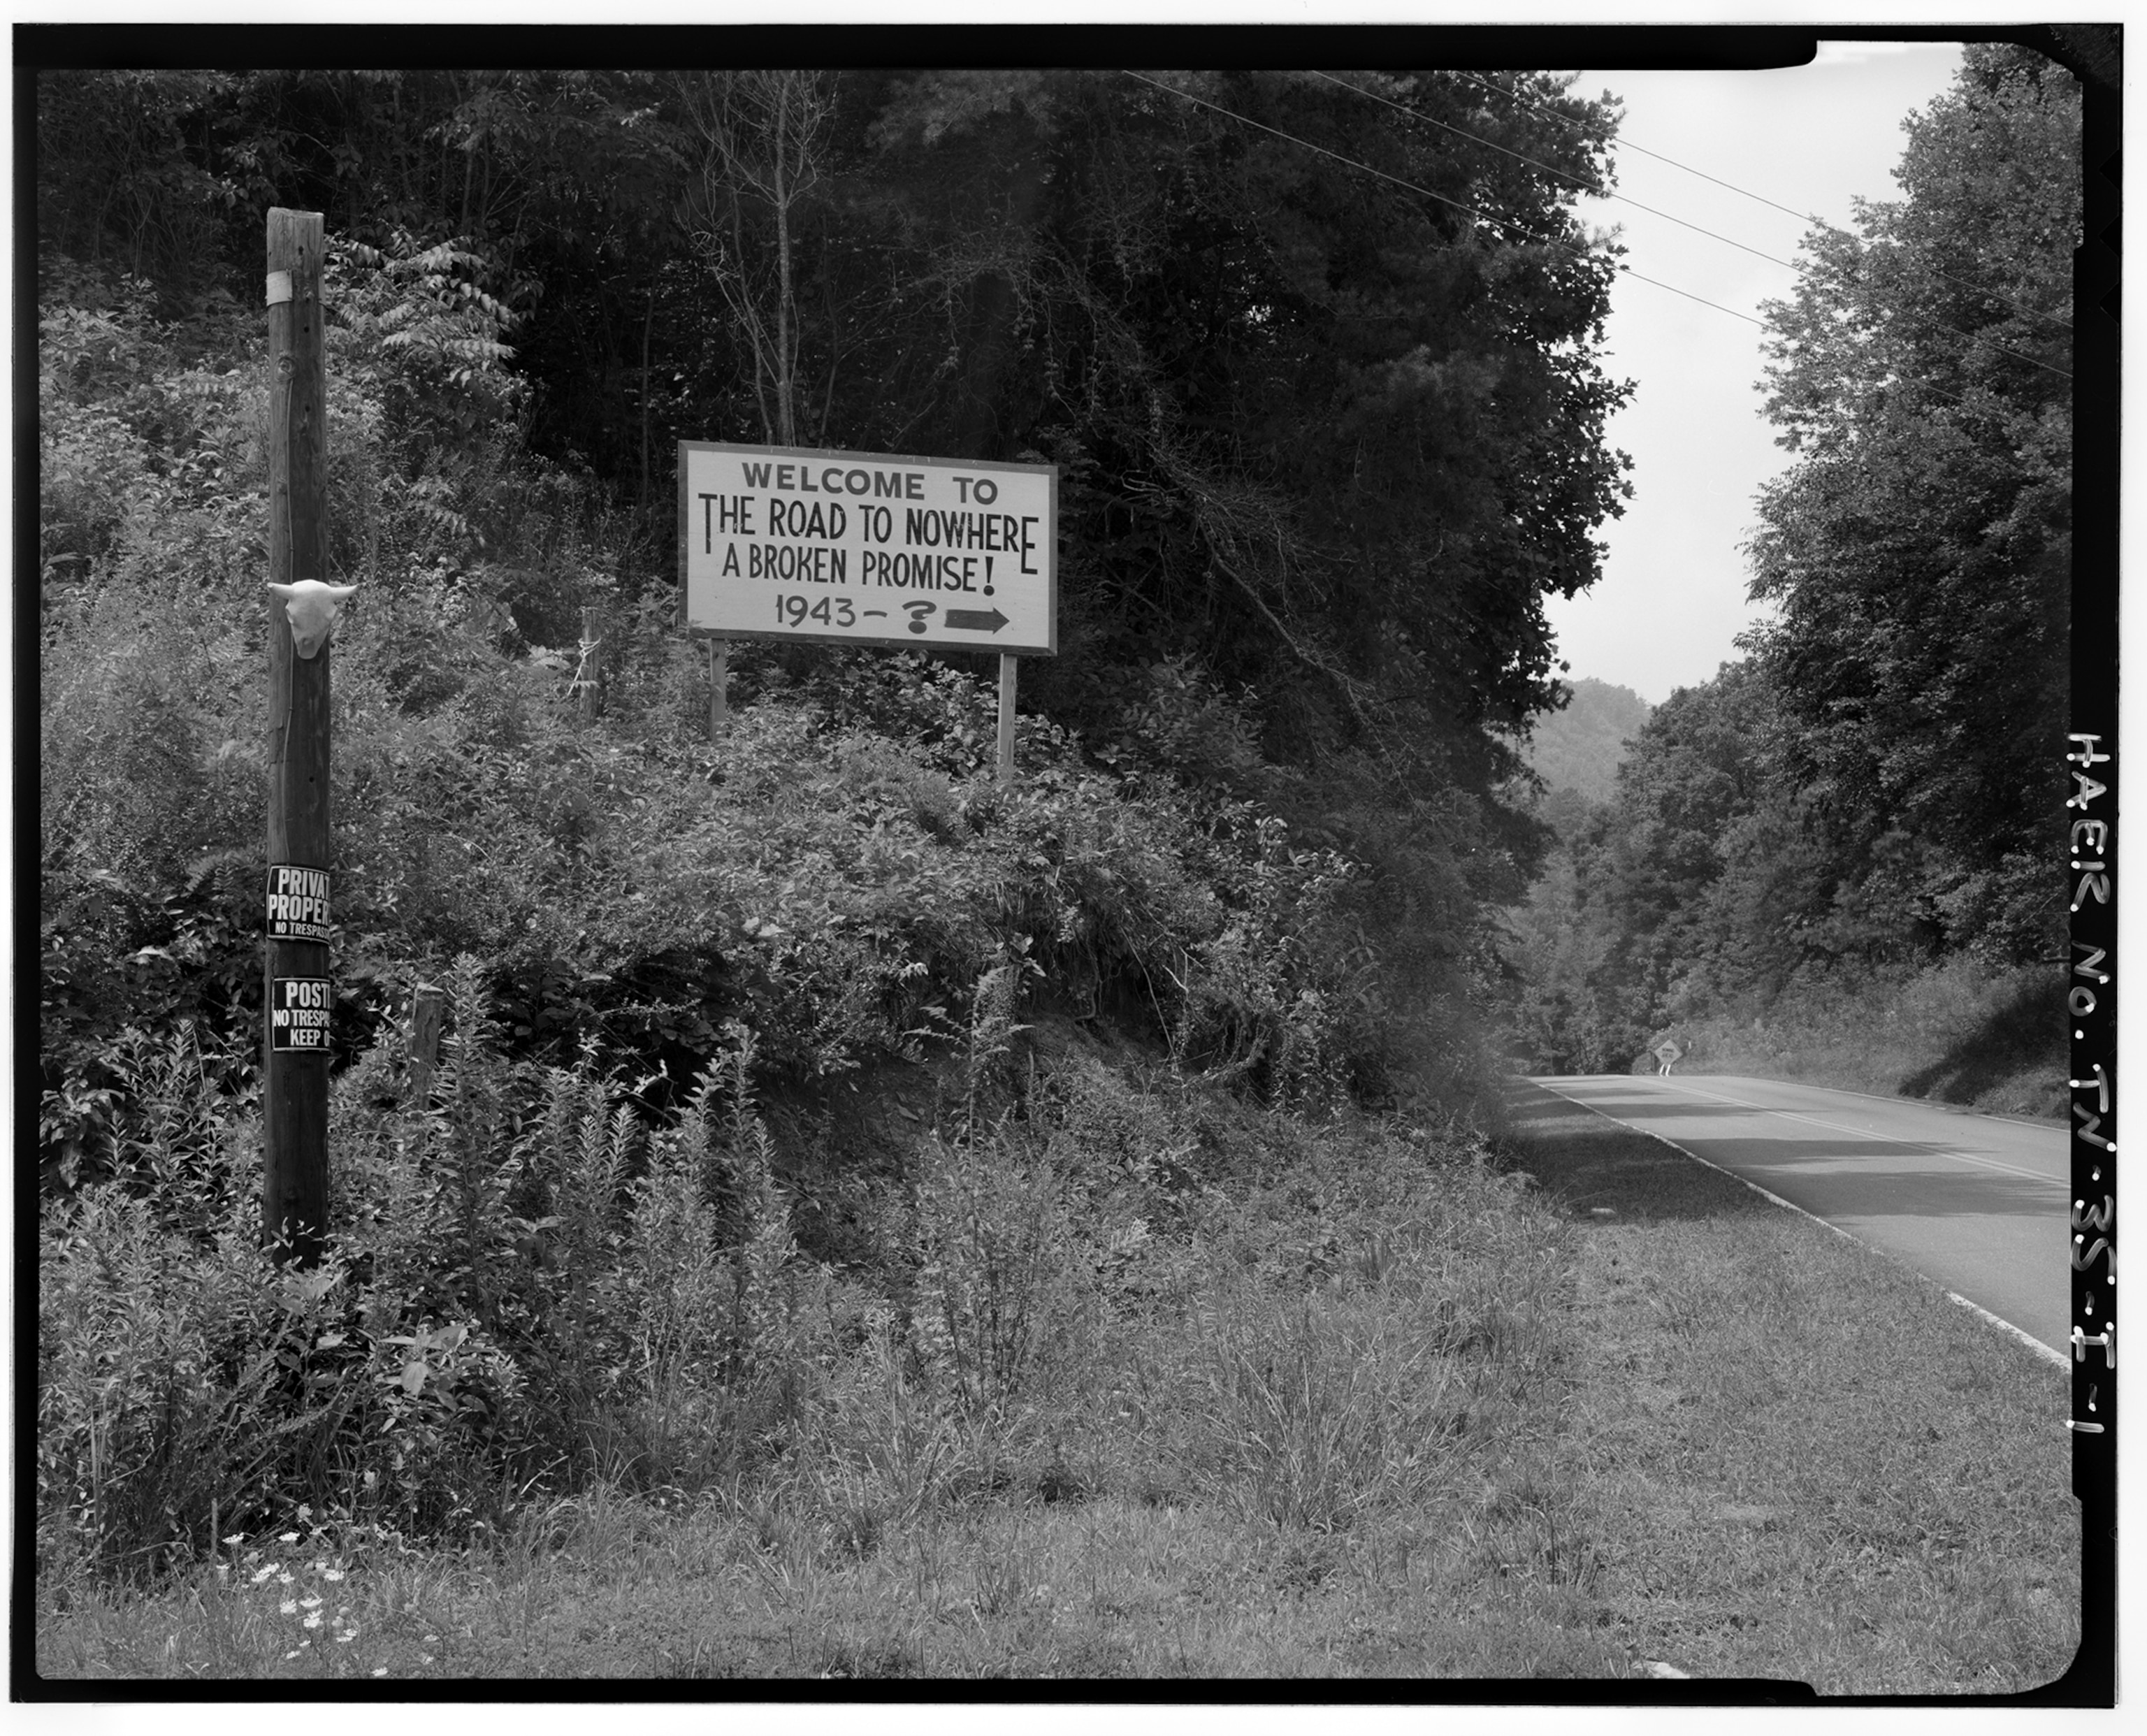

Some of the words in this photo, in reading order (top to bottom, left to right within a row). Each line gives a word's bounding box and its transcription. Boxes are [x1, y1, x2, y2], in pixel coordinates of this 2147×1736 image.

[742, 462, 925, 500] WELCOME
[953, 476, 999, 505] TO
[698, 493, 756, 554] THE
[769, 498, 846, 540] ROAD
[858, 504, 892, 544] TO
[906, 507, 1039, 575] NOWHERE
[722, 542, 741, 578] A
[749, 543, 846, 584] BROKEN
[862, 550, 995, 597] PROMISE!
[277, 868, 330, 900] PRIVAT
[268, 894, 328, 926] PROPER
[275, 921, 287, 934] NO
[273, 1009, 290, 1027] NO
[290, 1028, 321, 1046] KEEP
